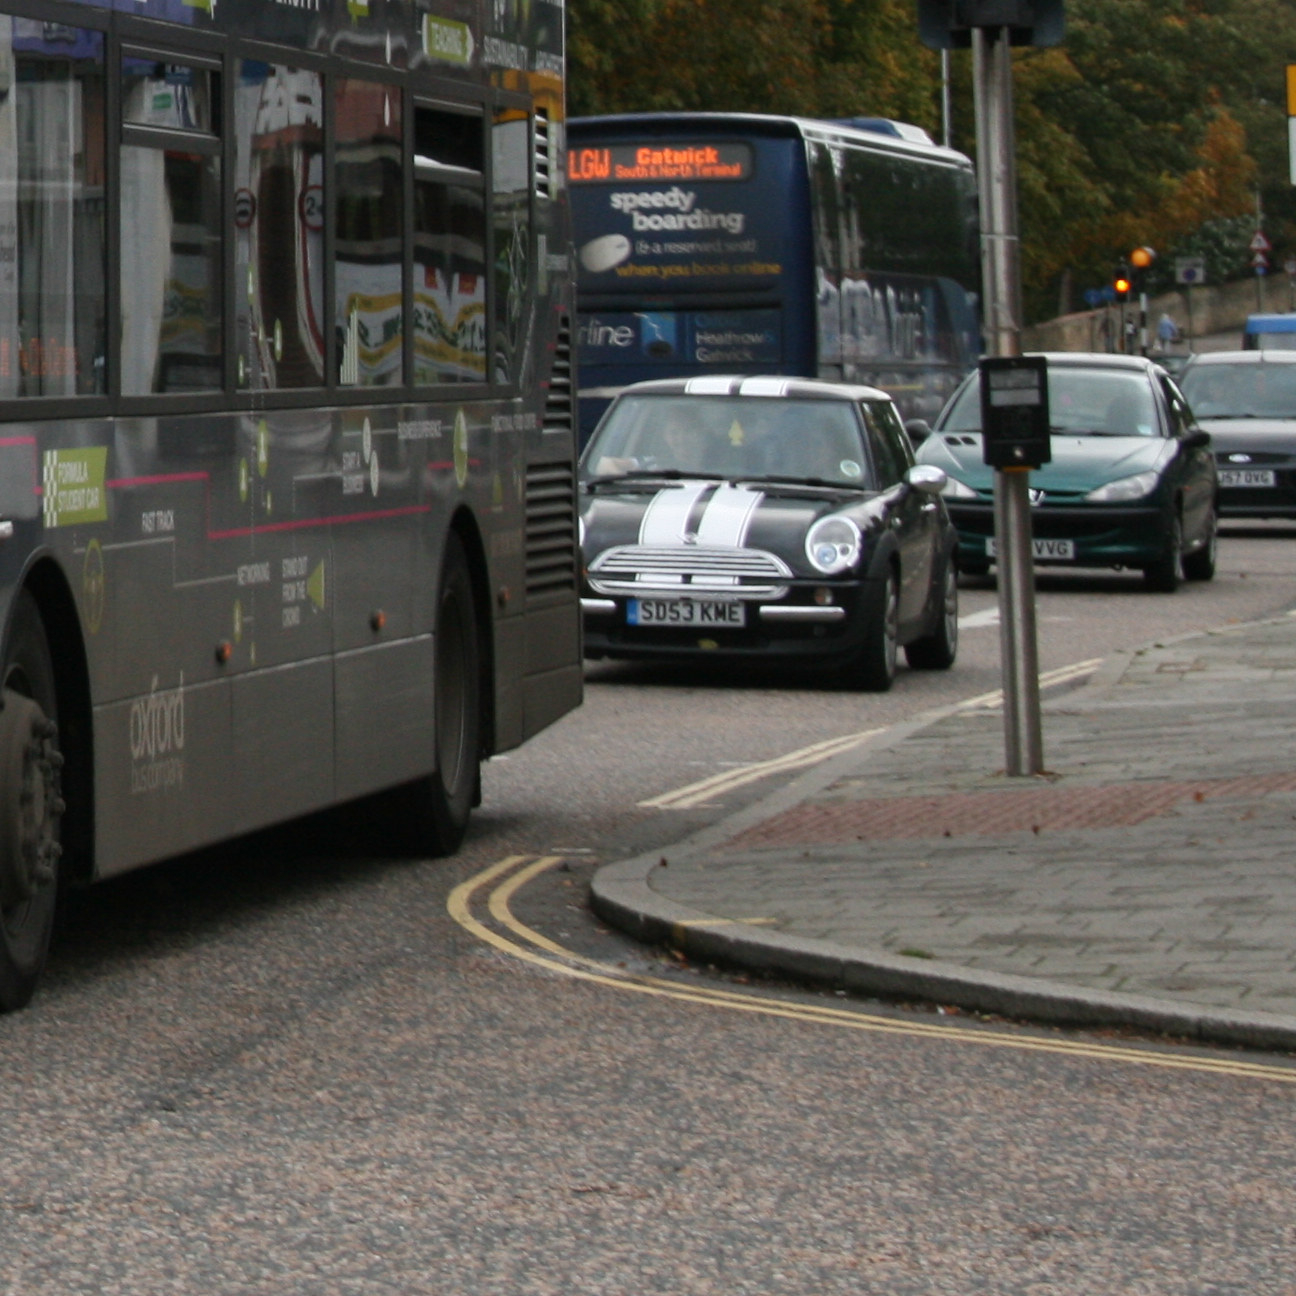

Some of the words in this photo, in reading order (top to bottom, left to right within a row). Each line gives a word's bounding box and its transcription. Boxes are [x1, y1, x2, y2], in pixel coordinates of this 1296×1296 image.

[568, 149, 611, 180] LGW
[636, 145, 719, 165] Gatwick
[615, 164, 649, 179] South
[658, 164, 693, 178] North
[696, 162, 742, 177] Terminal
[610, 186, 696, 213] speedy
[633, 208, 745, 234] boarding
[664, 239, 722, 254] reserved
[616, 262, 658, 277] when
[658, 264, 691, 280] you
[692, 261, 731, 276] book
[733, 261, 783, 275] online
[577, 320, 634, 347] rline
[696, 330, 764, 345] Heathrow
[696, 347, 755, 363] Gatwick
[58, 461, 88, 485] FORMULA
[58, 489, 86, 512] STUDENT
[86, 487, 99, 510] CAR
[142, 511, 155, 533] FAST
[156, 509, 175, 531] TRACK
[1034, 540, 1068, 556] VVG
[641, 601, 694, 622] SD53
[700, 602, 740, 623] KME
[130, 669, 185, 761] oxford
